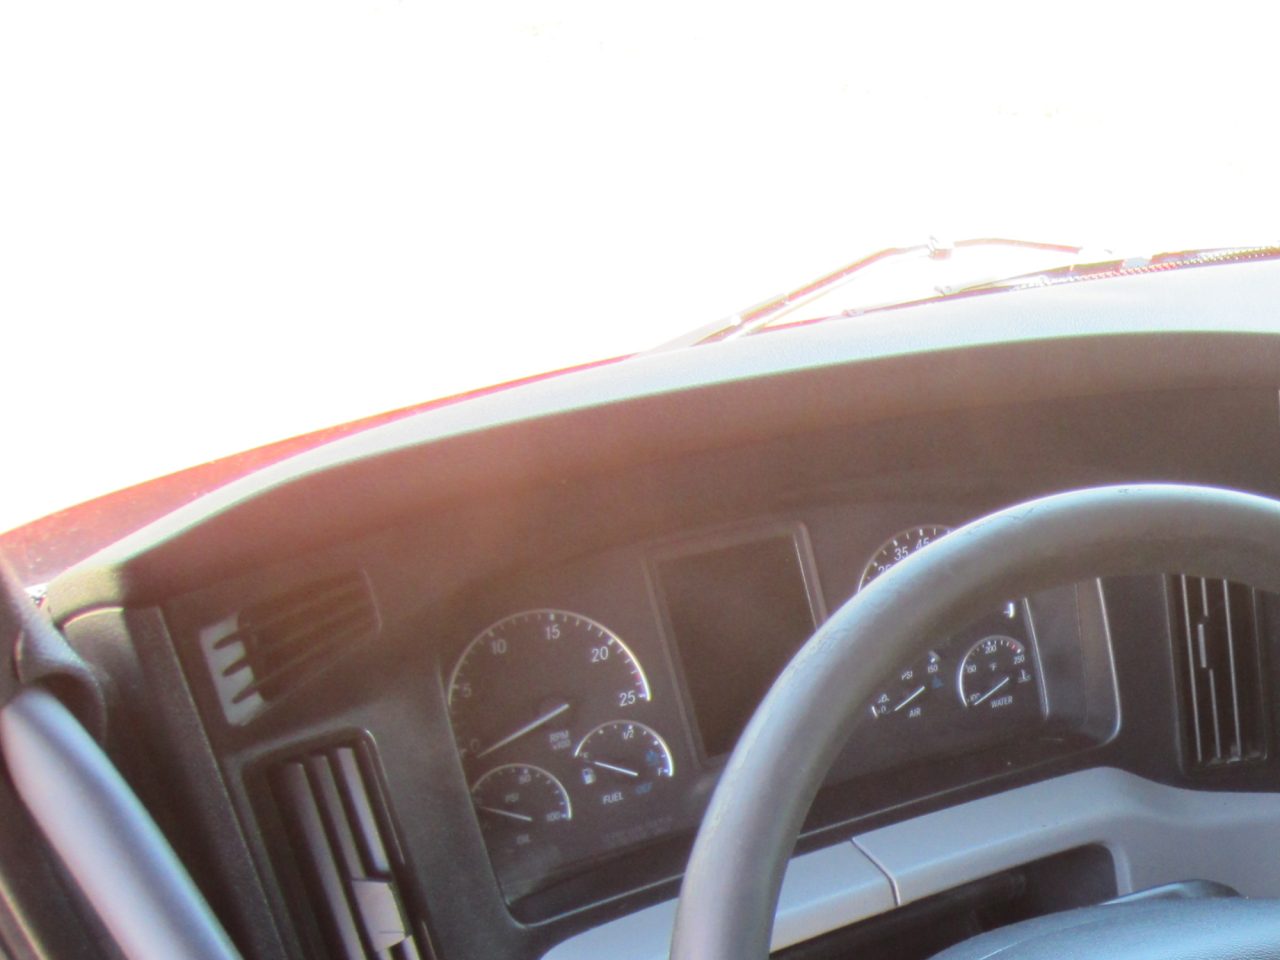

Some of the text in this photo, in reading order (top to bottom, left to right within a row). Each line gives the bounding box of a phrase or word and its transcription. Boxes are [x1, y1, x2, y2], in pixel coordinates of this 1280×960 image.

[546, 624, 560, 640] 15
[492, 638, 507, 654] 10
[591, 646, 609, 663] 20
[619, 691, 636, 706] 25
[991, 696, 1014, 709] WATER
[909, 707, 922, 719] AIR
[602, 792, 624, 805] FUEL
